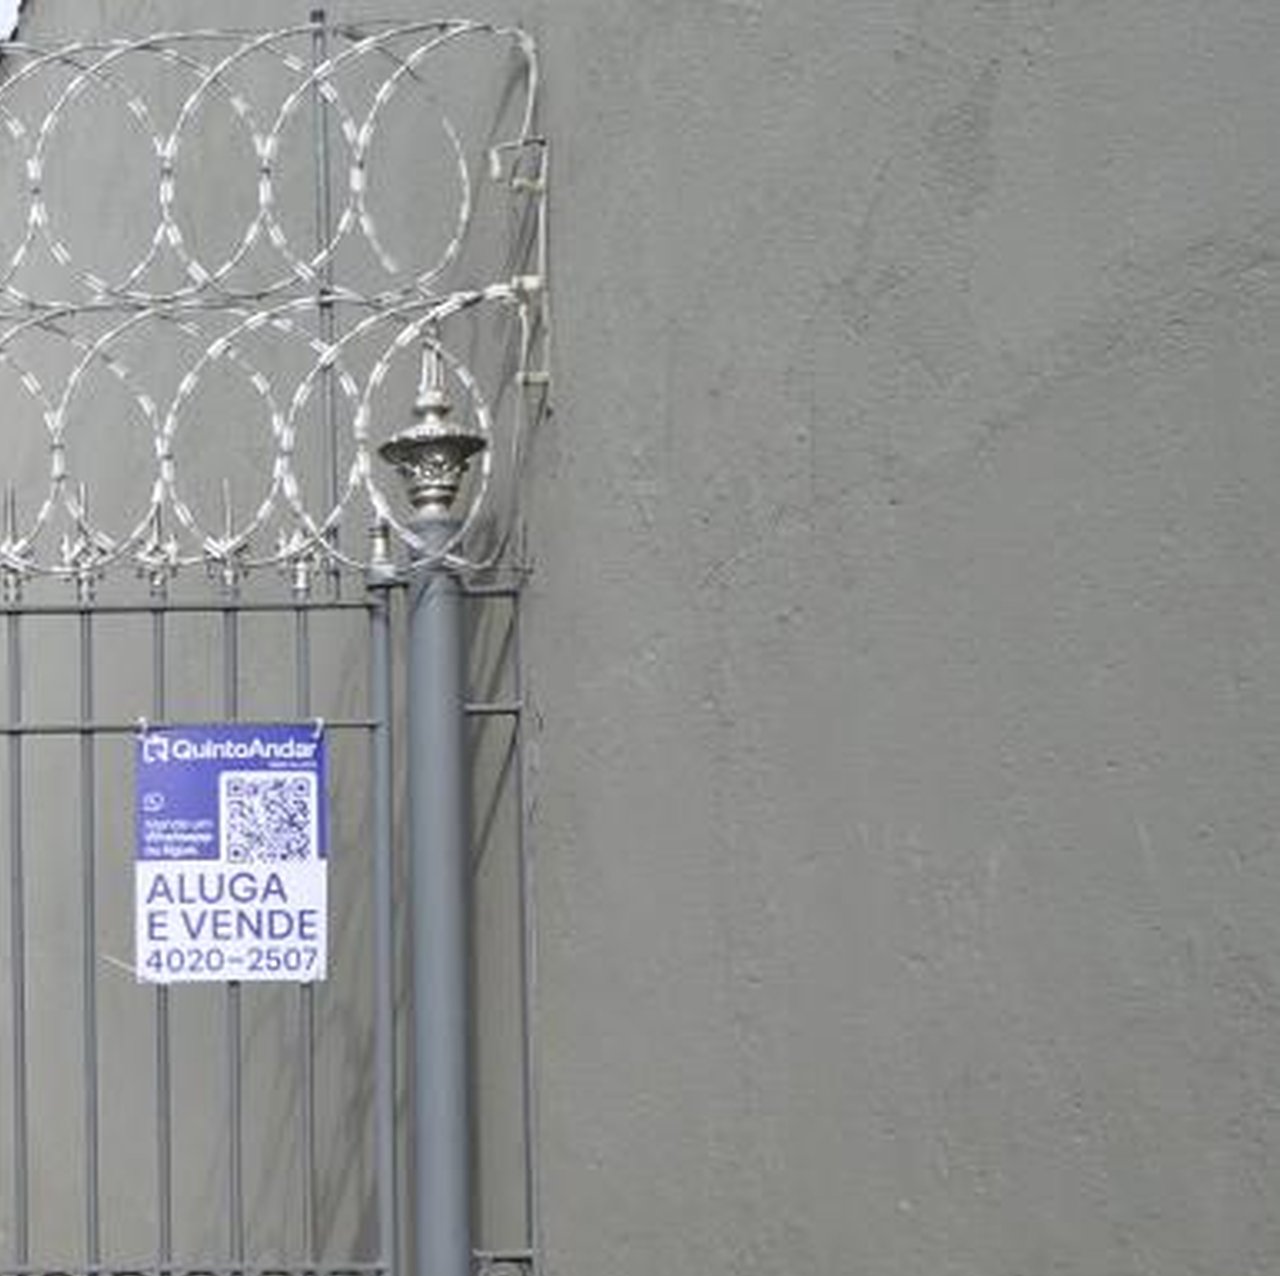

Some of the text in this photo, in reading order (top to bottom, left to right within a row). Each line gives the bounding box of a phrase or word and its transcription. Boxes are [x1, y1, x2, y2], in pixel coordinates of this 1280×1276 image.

[172, 738, 318, 760] QuintoAndar
[146, 872, 288, 904] ALUGA
[148, 910, 319, 941] E VENDE
[146, 948, 318, 973] 4020-2507
